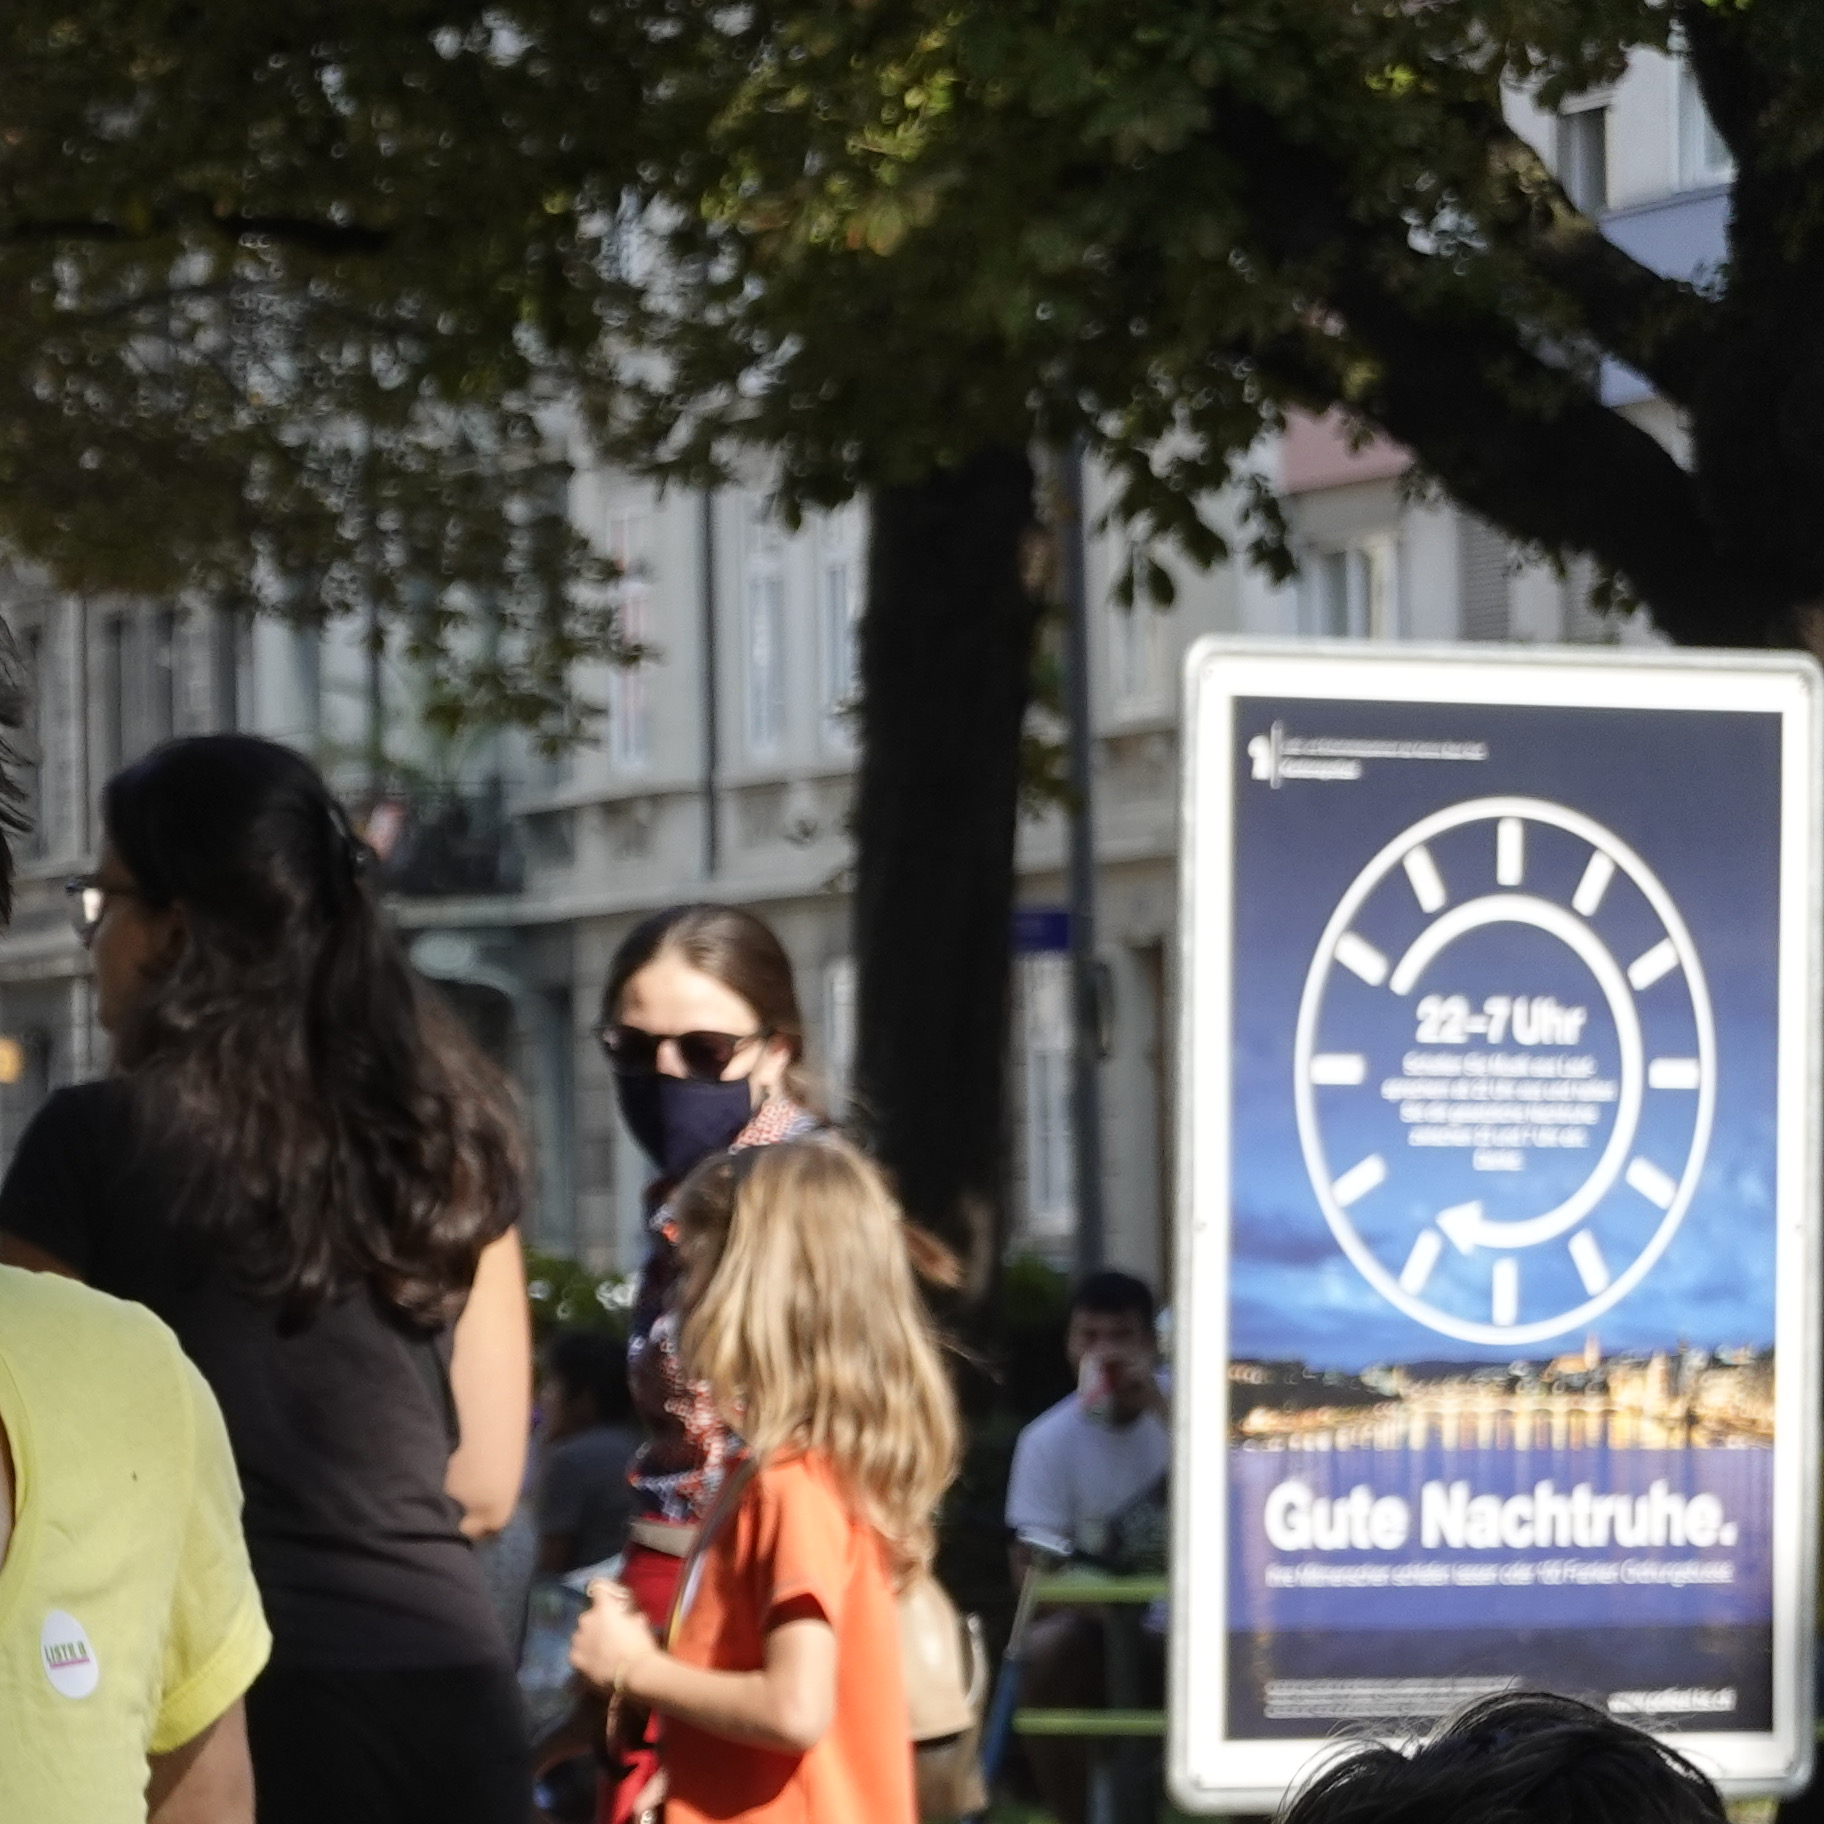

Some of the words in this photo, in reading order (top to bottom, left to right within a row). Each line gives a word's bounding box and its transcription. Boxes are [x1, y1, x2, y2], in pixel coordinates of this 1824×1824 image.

[1512, 995, 1587, 1045] Uhr
[1264, 1478, 1409, 1551] Gute
[1421, 1480, 1737, 1548] Nachtruhe.
